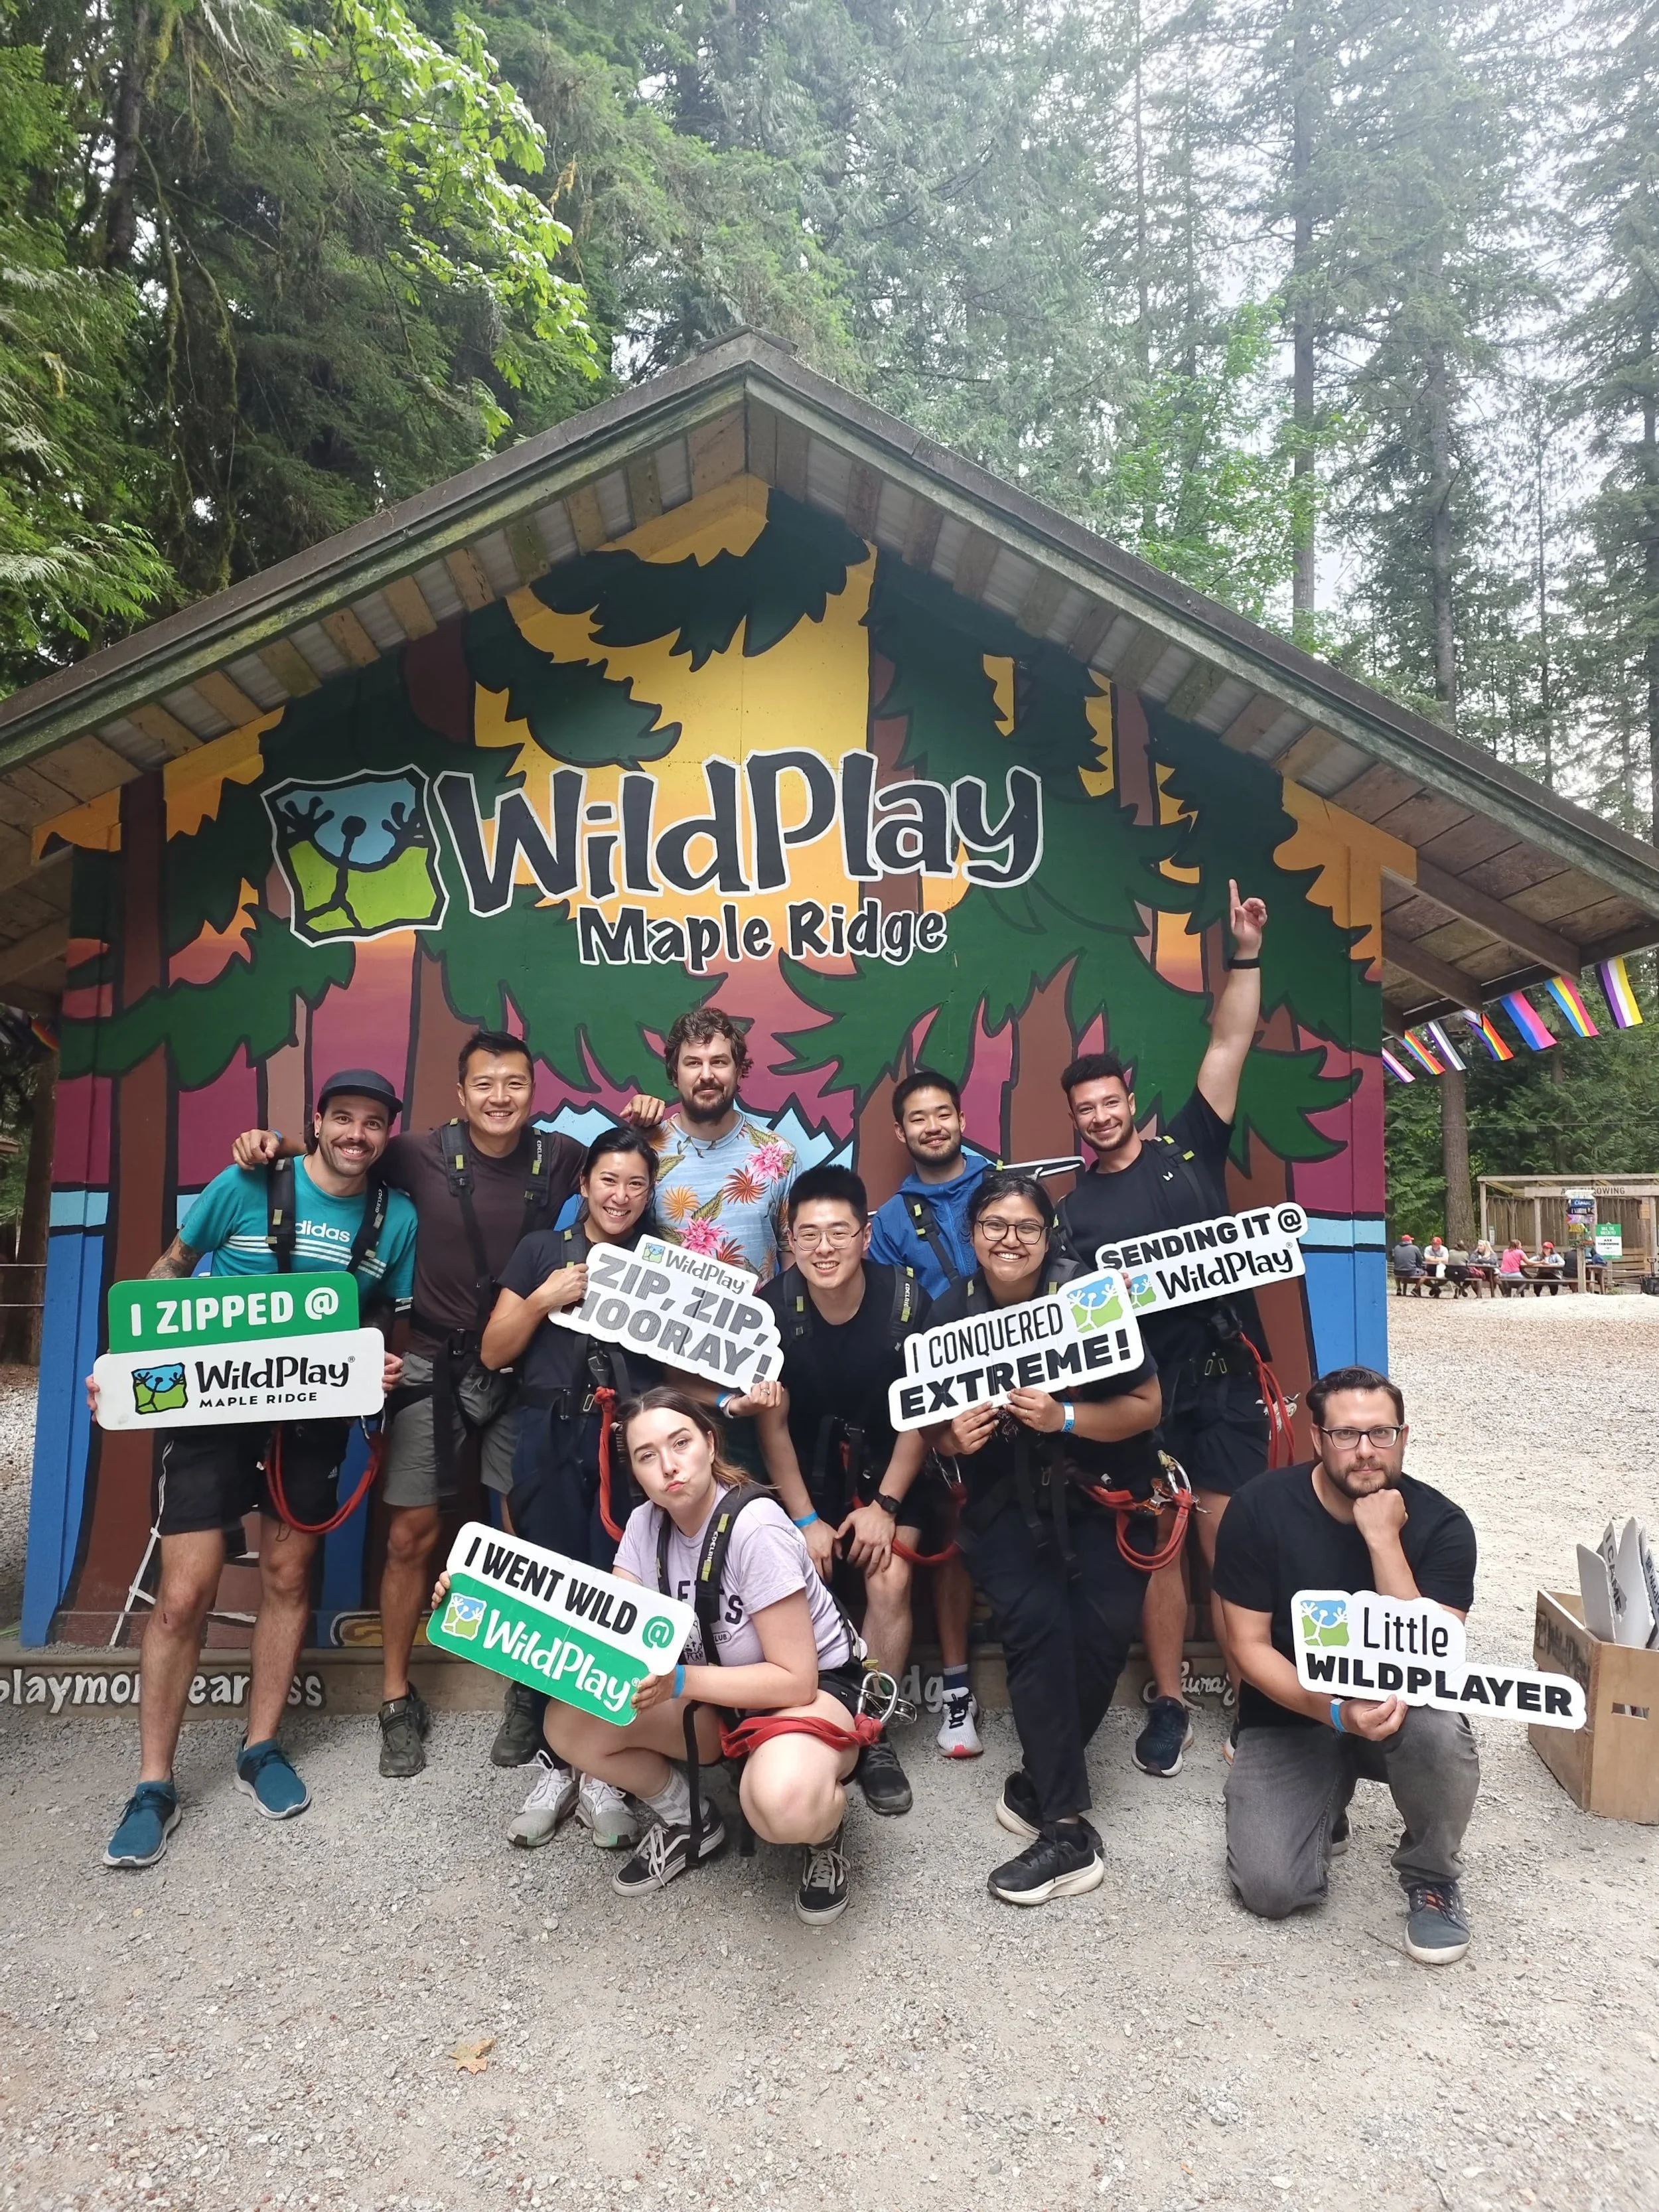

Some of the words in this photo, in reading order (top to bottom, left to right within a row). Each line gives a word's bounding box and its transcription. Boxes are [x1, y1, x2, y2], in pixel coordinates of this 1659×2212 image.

[434, 748, 1043, 917] WildPlay
[578, 902, 774, 972] Maple
[788, 900, 948, 965] Ridge
[295, 1220, 350, 1243] didas
[1101, 1222, 1238, 1270] SENDING
[1242, 1212, 1271, 1239] IT
[1277, 1209, 1303, 1233] @
[131, 1303, 142, 1336] I
[157, 1291, 293, 1334] ZIPPED
[305, 1287, 339, 1321] @
[589, 1253, 676, 1311] ZIP,
[683, 1286, 768, 1347] ZIP,
[560, 1290, 772, 1384] HOORAY!
[912, 1342, 919, 1373] I
[929, 1303, 1063, 1368] CONQUERED
[199, 1396, 258, 1408] MAPLE
[266, 1392, 317, 1404] RIDGE
[899, 1328, 1131, 1420] EXTREME!
[707, 1530, 719, 1564] EDELRI
[465, 1536, 482, 1567] I
[482, 1542, 565, 1602] WENT
[565, 1577, 638, 1635] WILD
[642, 1615, 674, 1649] @
[1363, 1607, 1449, 1658] Little
[1306, 1653, 1573, 1716] WILDPLAYER
